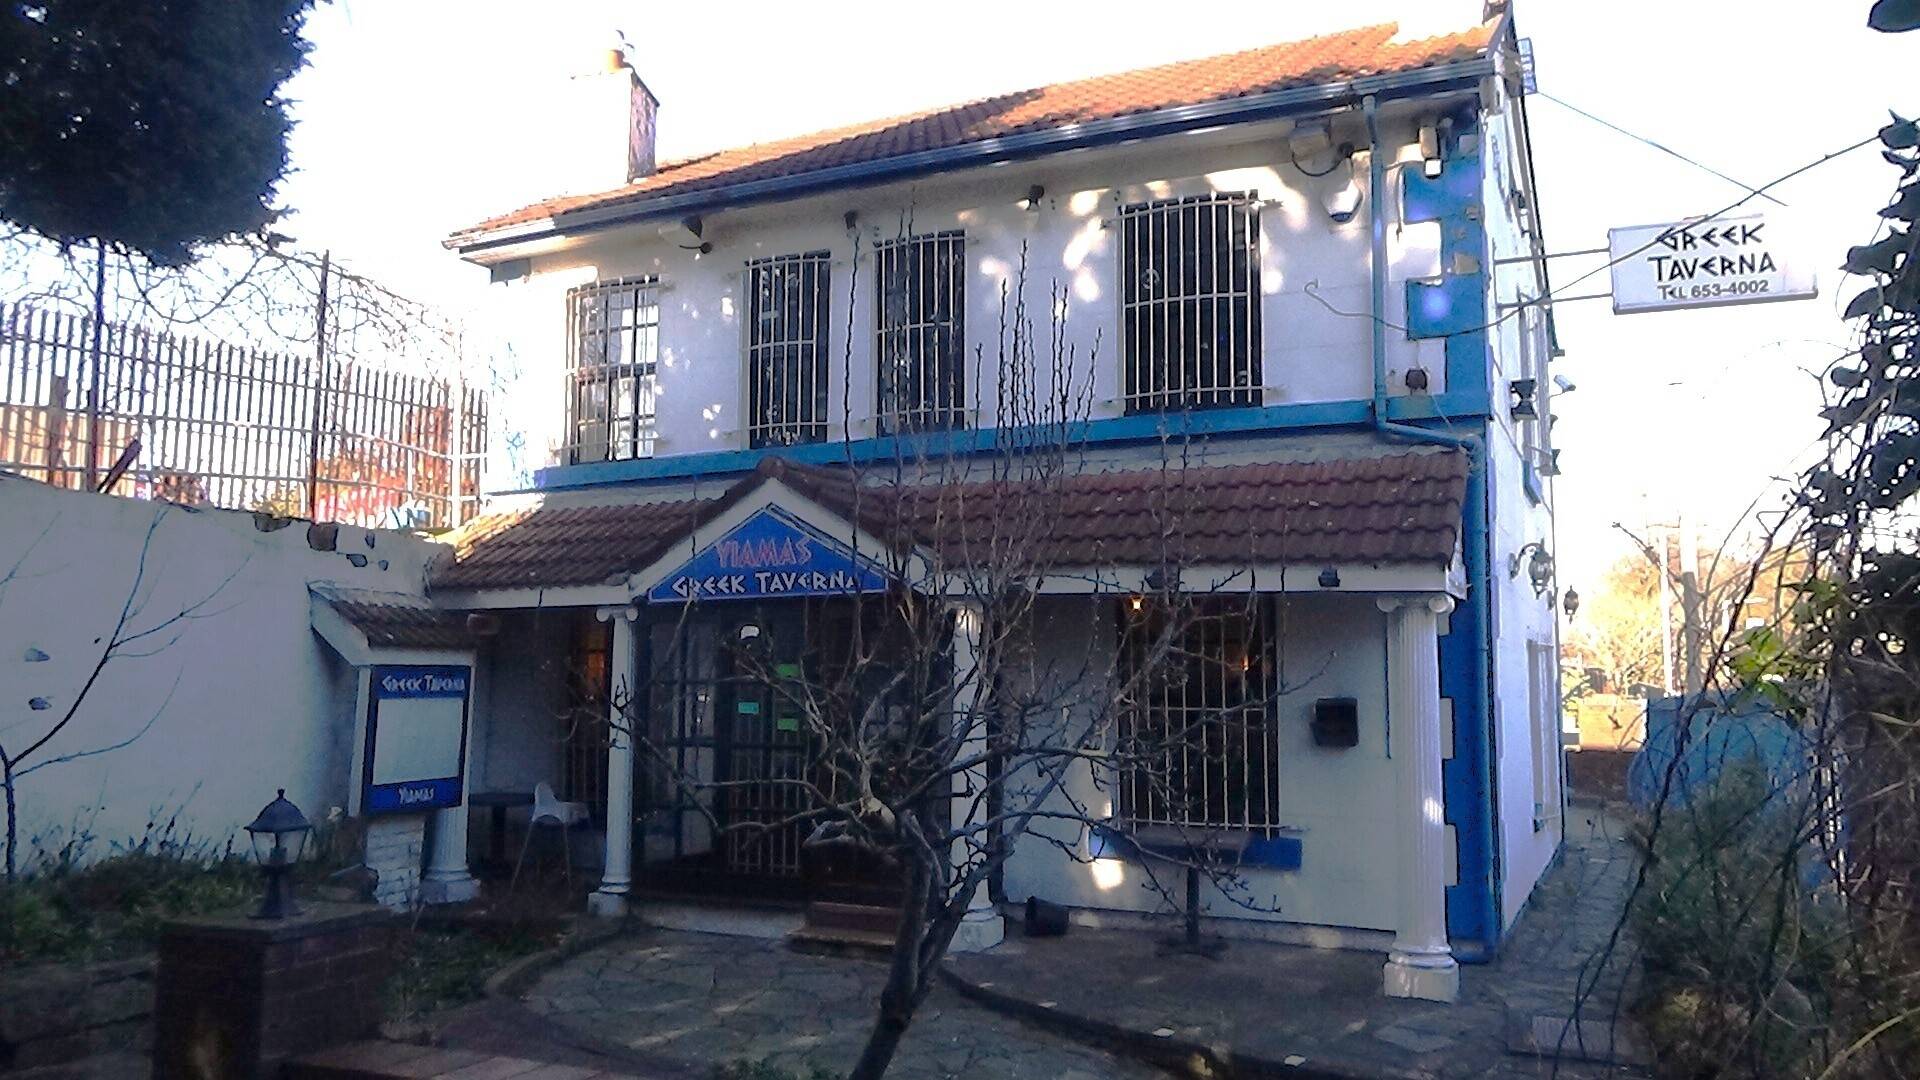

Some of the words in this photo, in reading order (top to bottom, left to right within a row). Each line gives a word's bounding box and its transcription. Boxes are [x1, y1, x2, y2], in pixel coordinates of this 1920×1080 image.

[1656, 222, 1765, 251] GREEK
[1647, 251, 1777, 282] TAVERNA
[1657, 284, 1687, 300] TEL
[1691, 279, 1769, 298] 653-4002
[715, 535, 813, 568] YIAMAS
[671, 574, 746, 597] GREEK
